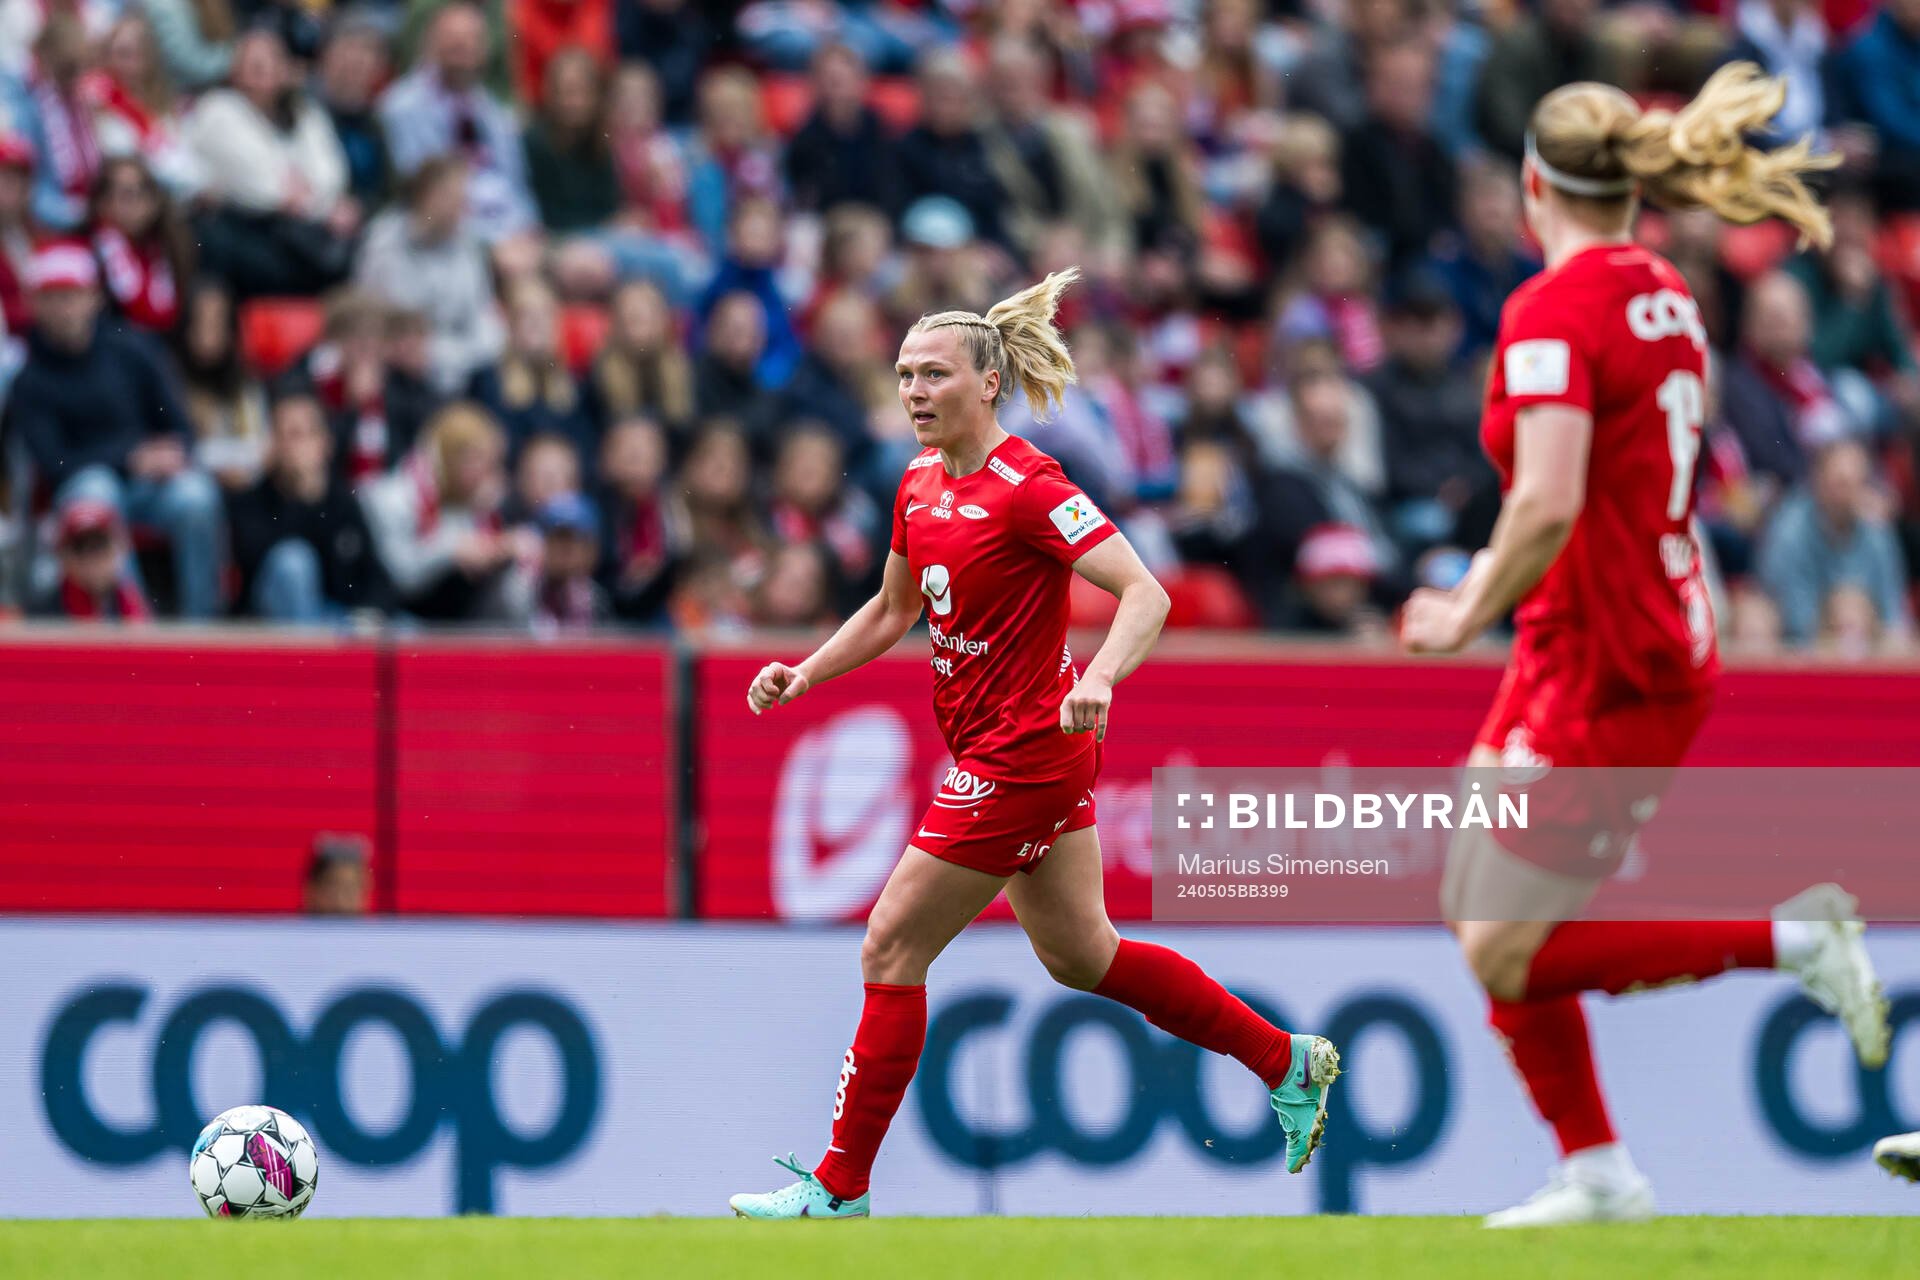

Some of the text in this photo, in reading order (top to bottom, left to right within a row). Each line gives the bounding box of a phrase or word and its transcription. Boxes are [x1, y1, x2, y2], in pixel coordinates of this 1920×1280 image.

[931, 507, 953, 520] OBOS
[1068, 525, 1085, 540] Norsk
[944, 768, 991, 796] RØY
[42, 980, 605, 1213] coop
[833, 1047, 858, 1120] coop
